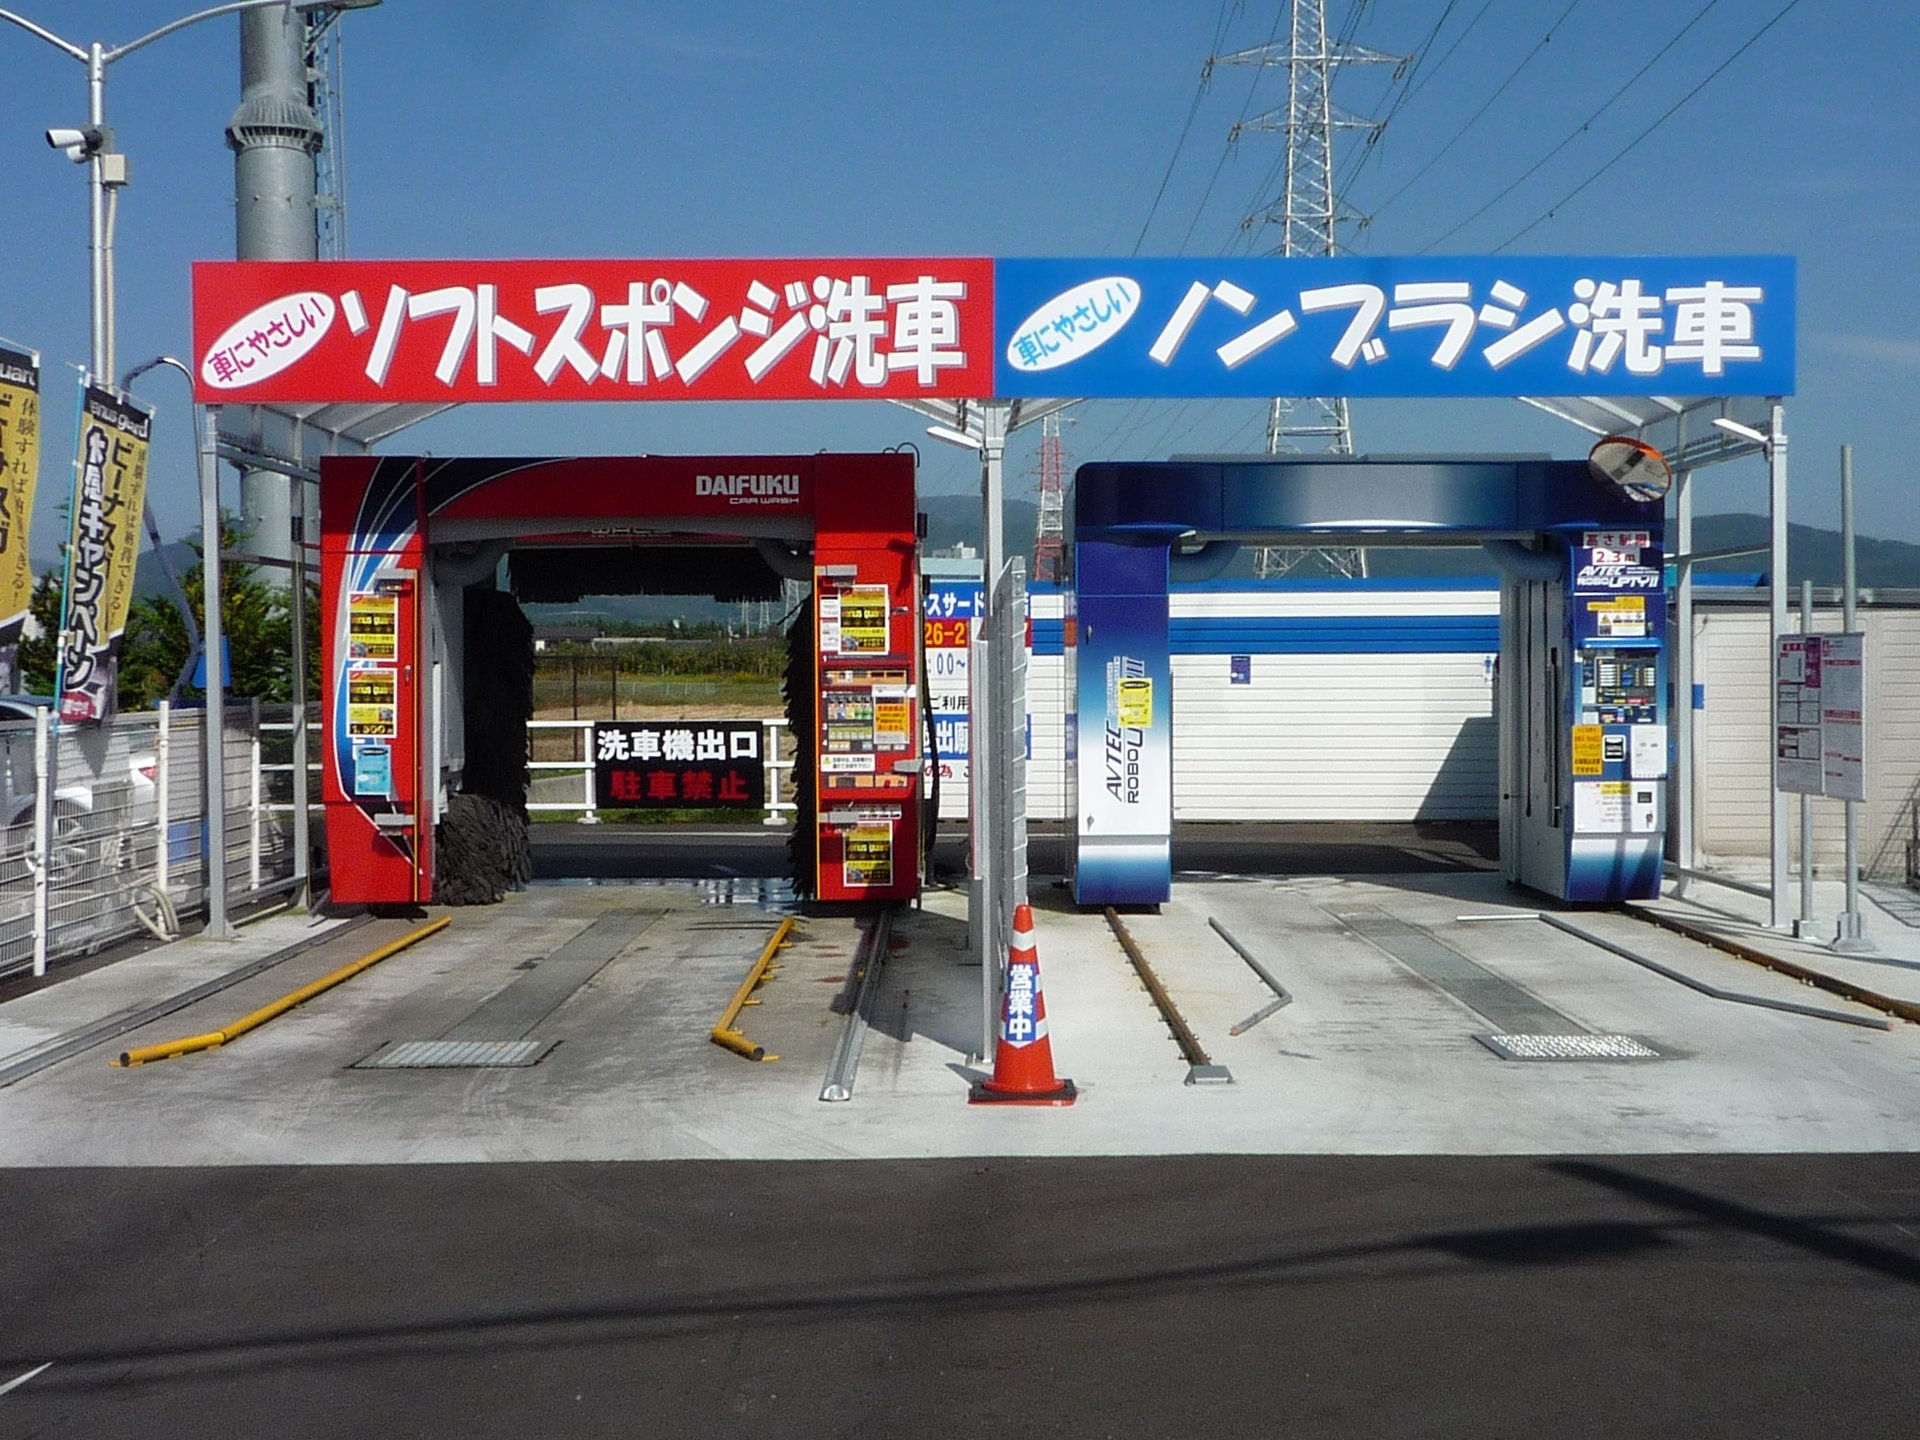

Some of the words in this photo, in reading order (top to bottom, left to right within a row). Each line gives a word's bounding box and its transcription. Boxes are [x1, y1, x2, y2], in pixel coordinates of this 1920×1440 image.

[208, 297, 325, 381] 車にやさしい
[341, 276, 966, 388] ソフトスポンジ洗車
[1012, 282, 1131, 367] 車にやさしい
[1149, 279, 1762, 376] ノンブラシ洗車
[696, 475, 799, 495] DAIFUKU
[1586, 532, 1648, 547] 高さ制限
[1578, 566, 1626, 575] AVTEC
[923, 591, 985, 618] スサード
[924, 622, 970, 645] 26-2
[597, 729, 758, 761] 洗車機出口
[1106, 720, 1122, 803] AVTEC
[611, 770, 749, 800] 駐車禁止
[1009, 964, 1033, 1040] 営業中
